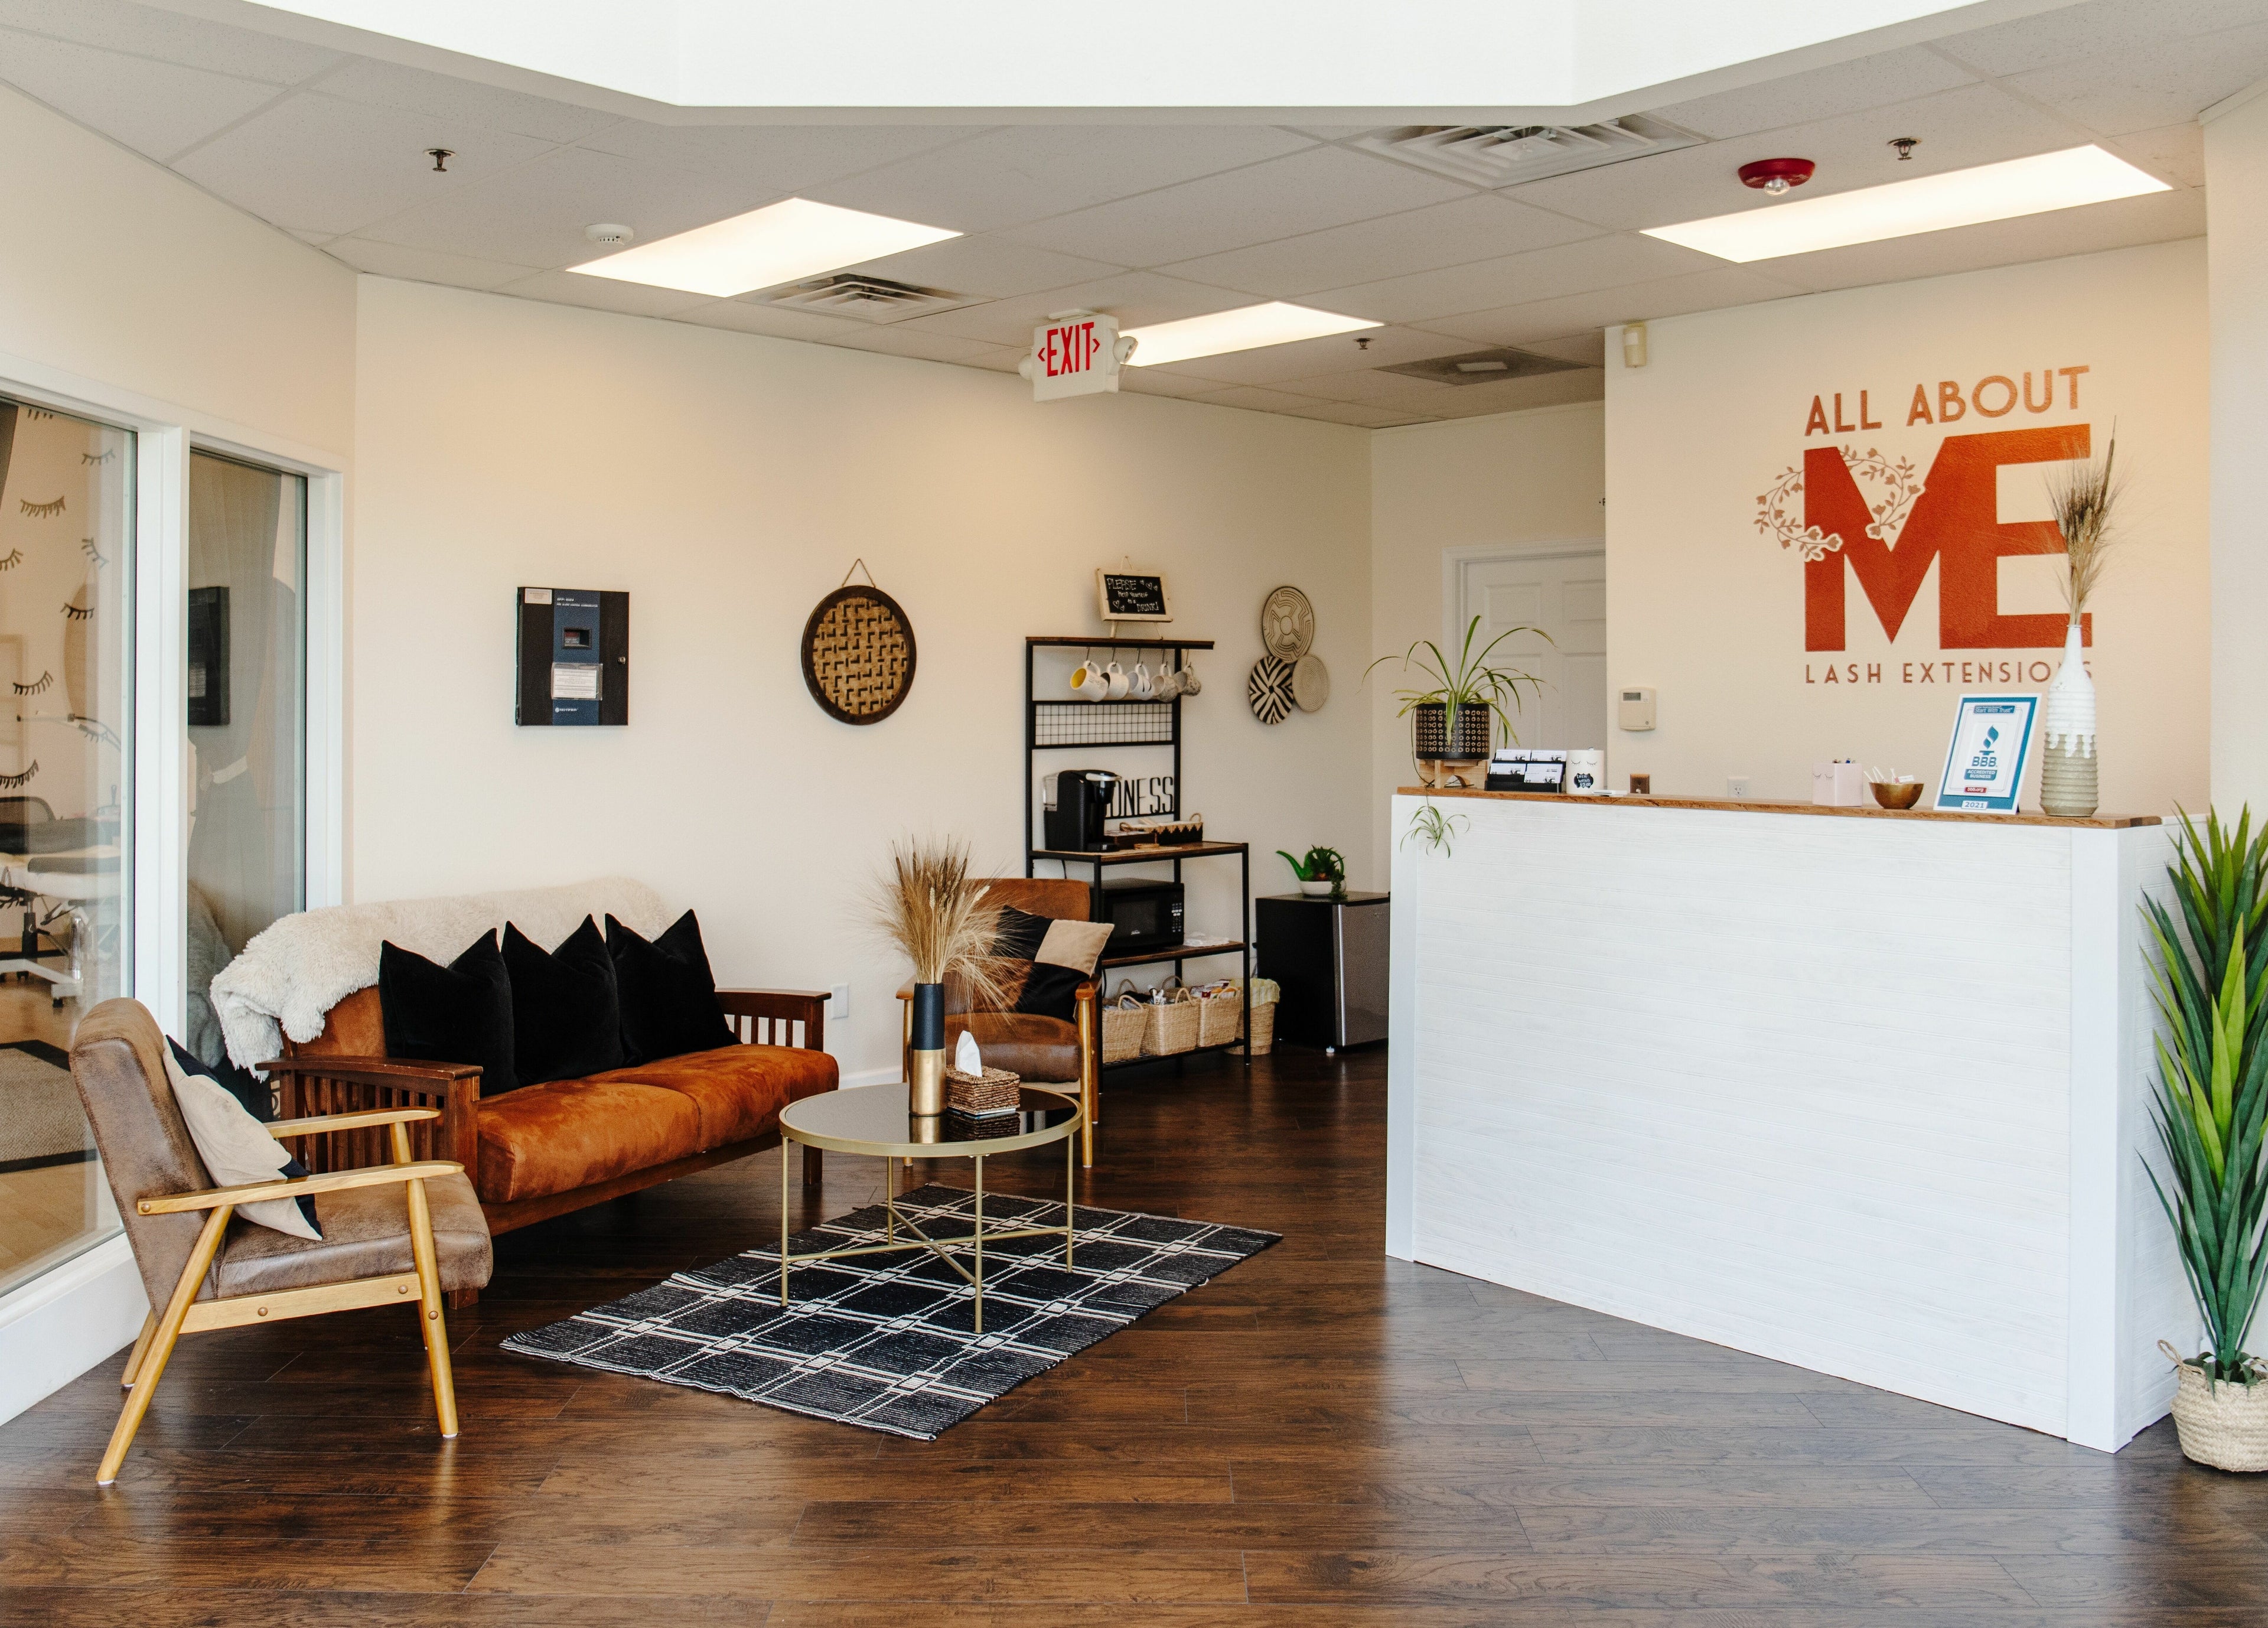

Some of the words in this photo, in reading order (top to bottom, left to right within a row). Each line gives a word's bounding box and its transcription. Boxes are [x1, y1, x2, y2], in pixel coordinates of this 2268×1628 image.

[1047, 322, 1094, 377] EXIT
[1804, 390, 1882, 436] ALL
[1907, 365, 2090, 426] ABOUT
[1804, 423, 2092, 652] ME
[1107, 578, 1136, 590] PLEASE
[1805, 663, 1882, 684] LASH
[1902, 660, 2091, 683] EXTENSIO
[1972, 756, 1996, 767] BBB
[1110, 777, 1174, 818] DNESS
